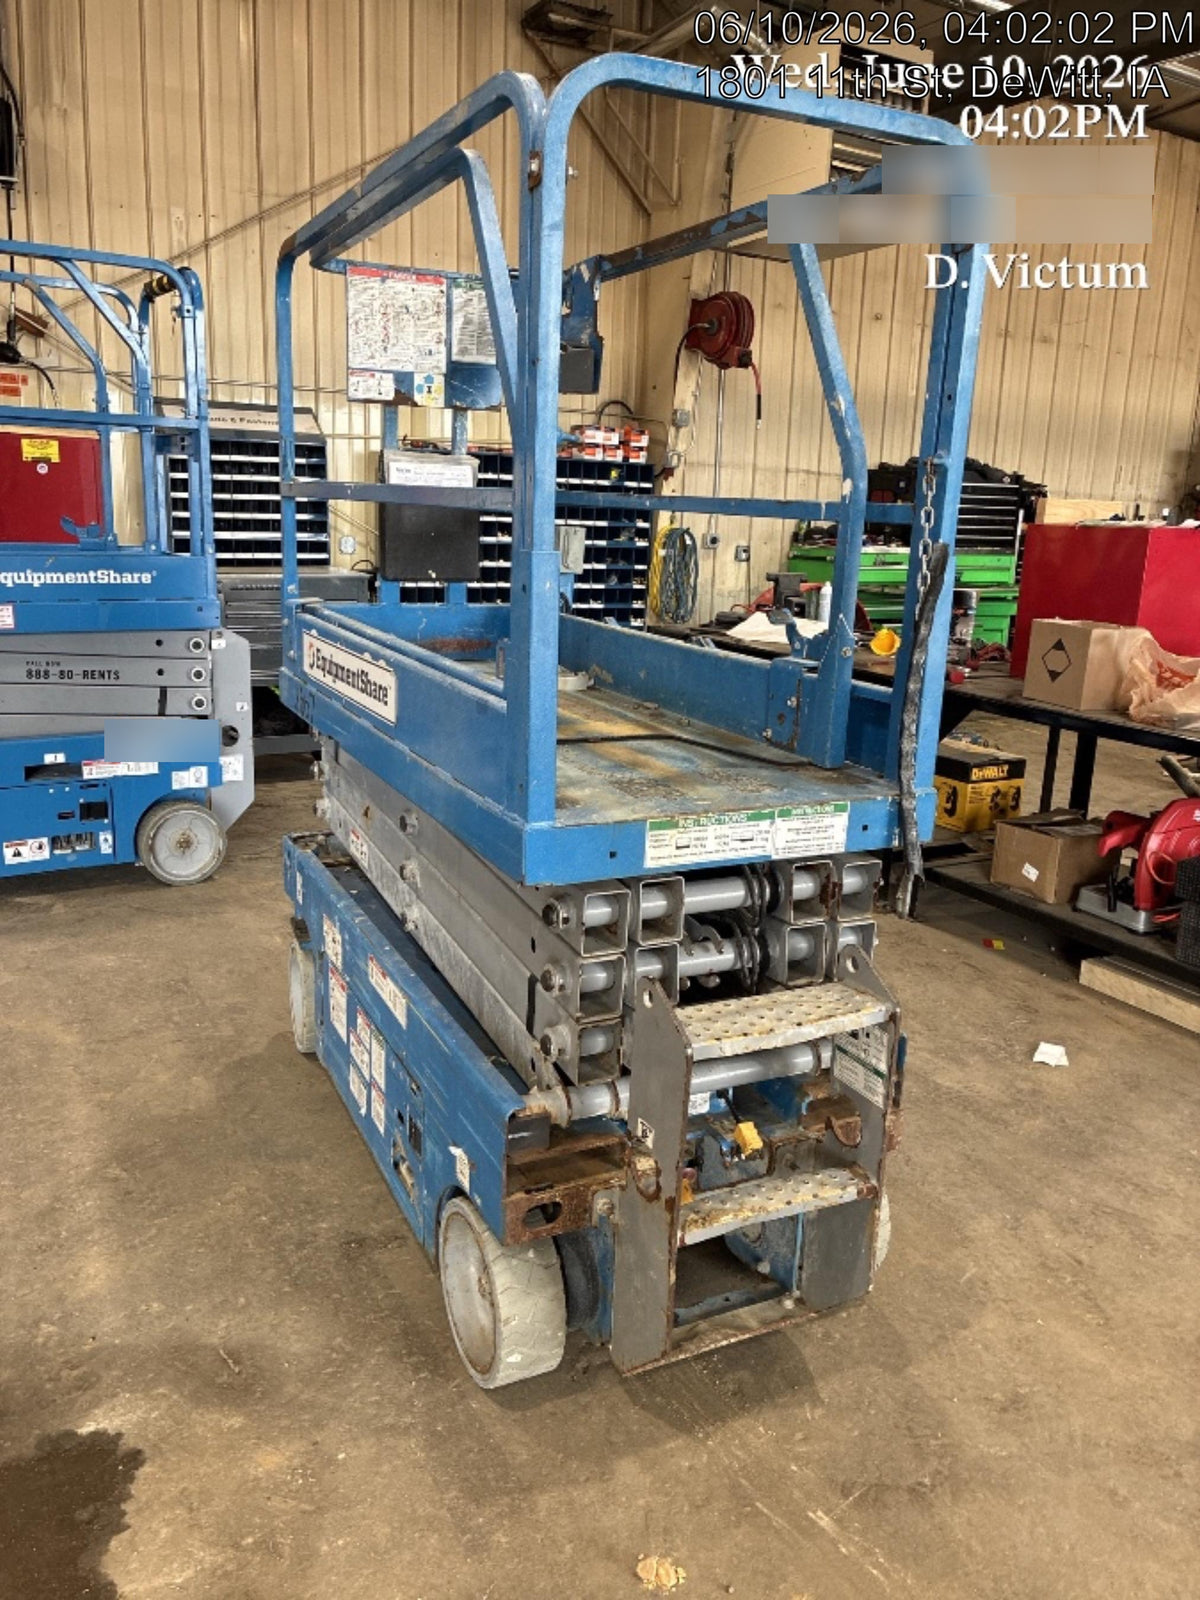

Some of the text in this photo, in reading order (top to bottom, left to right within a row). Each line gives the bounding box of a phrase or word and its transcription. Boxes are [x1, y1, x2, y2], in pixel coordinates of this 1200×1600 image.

[0, 569, 152, 587] quipmentShare
[26, 669, 120, 680] 888-80-RENTS
[315, 647, 389, 706] EquipmentShare
